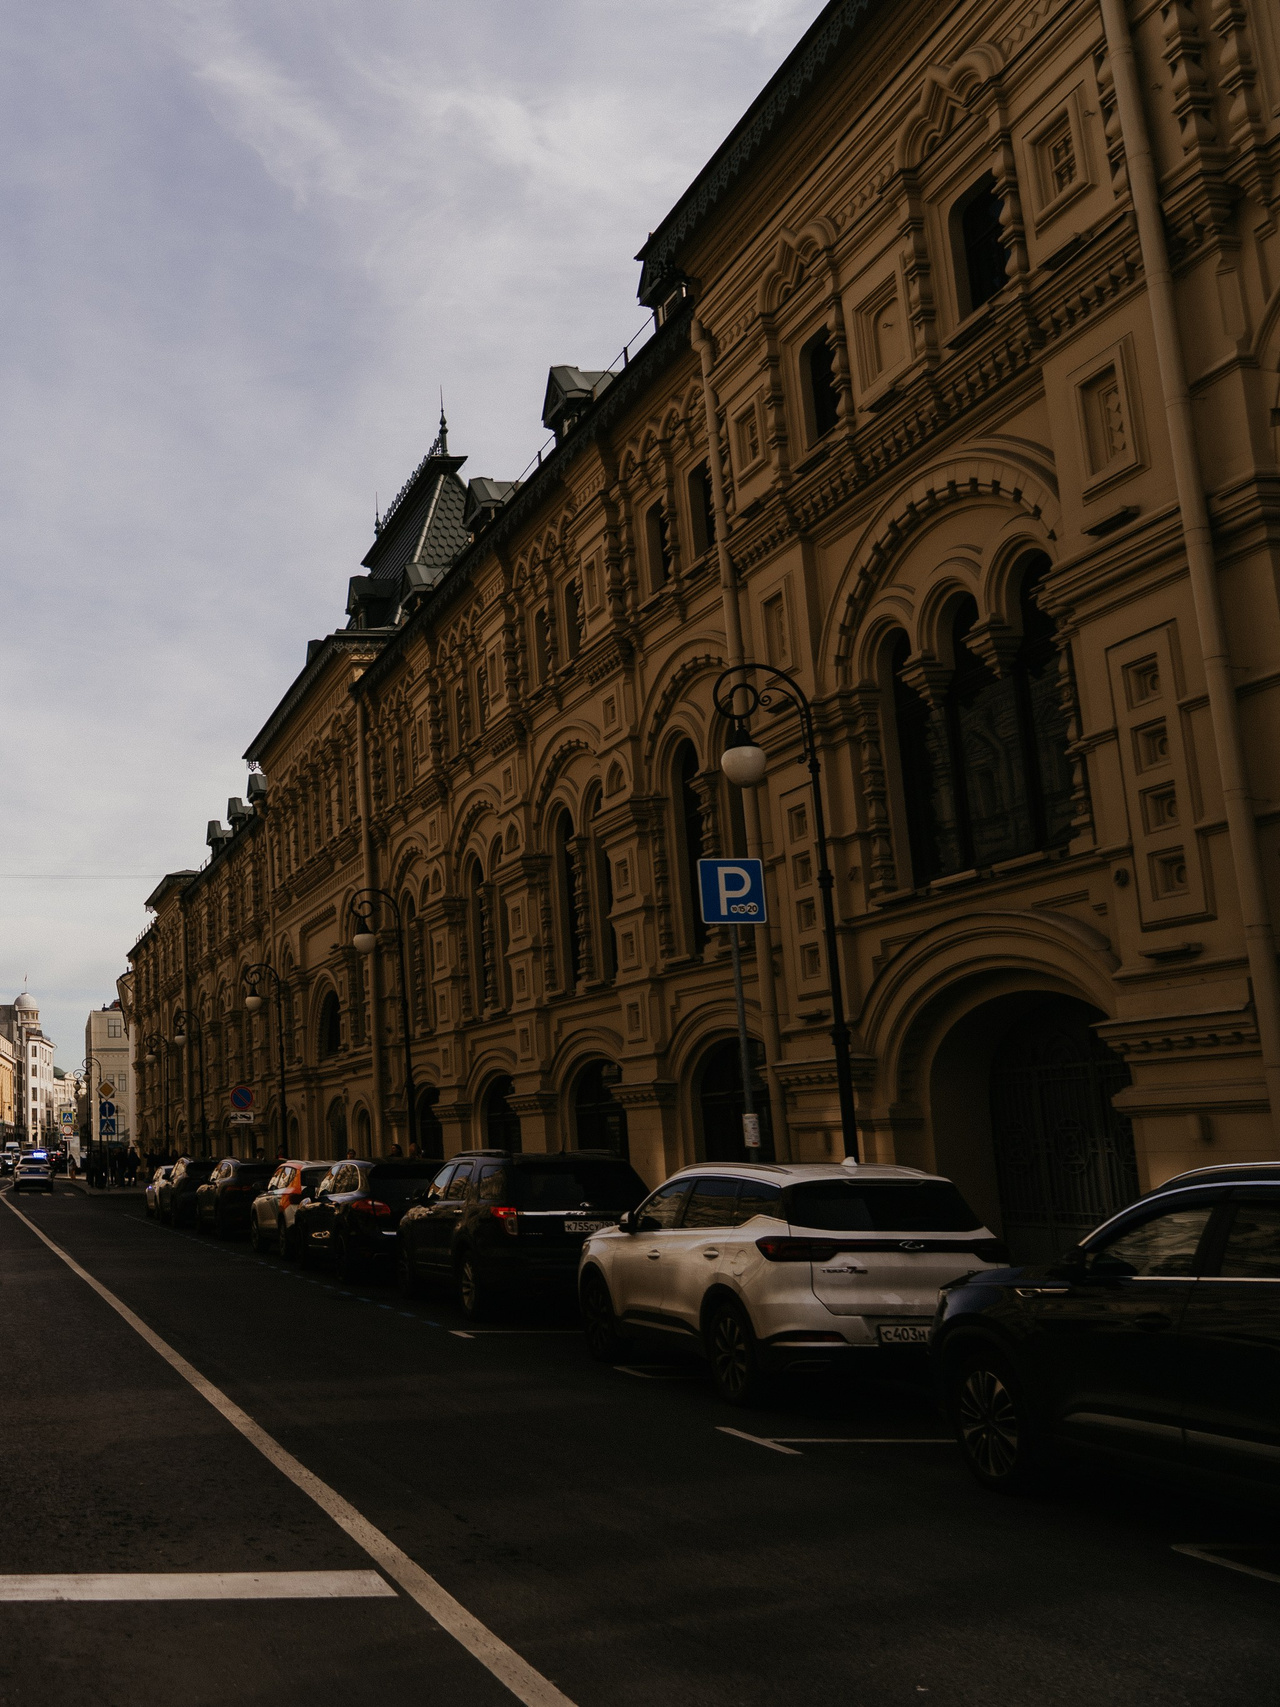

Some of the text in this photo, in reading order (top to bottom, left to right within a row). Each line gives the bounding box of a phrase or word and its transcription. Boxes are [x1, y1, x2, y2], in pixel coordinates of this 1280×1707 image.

[717, 866, 752, 916] P
[747, 904, 758, 913] 20
[883, 1328, 928, 1341] С403Н
